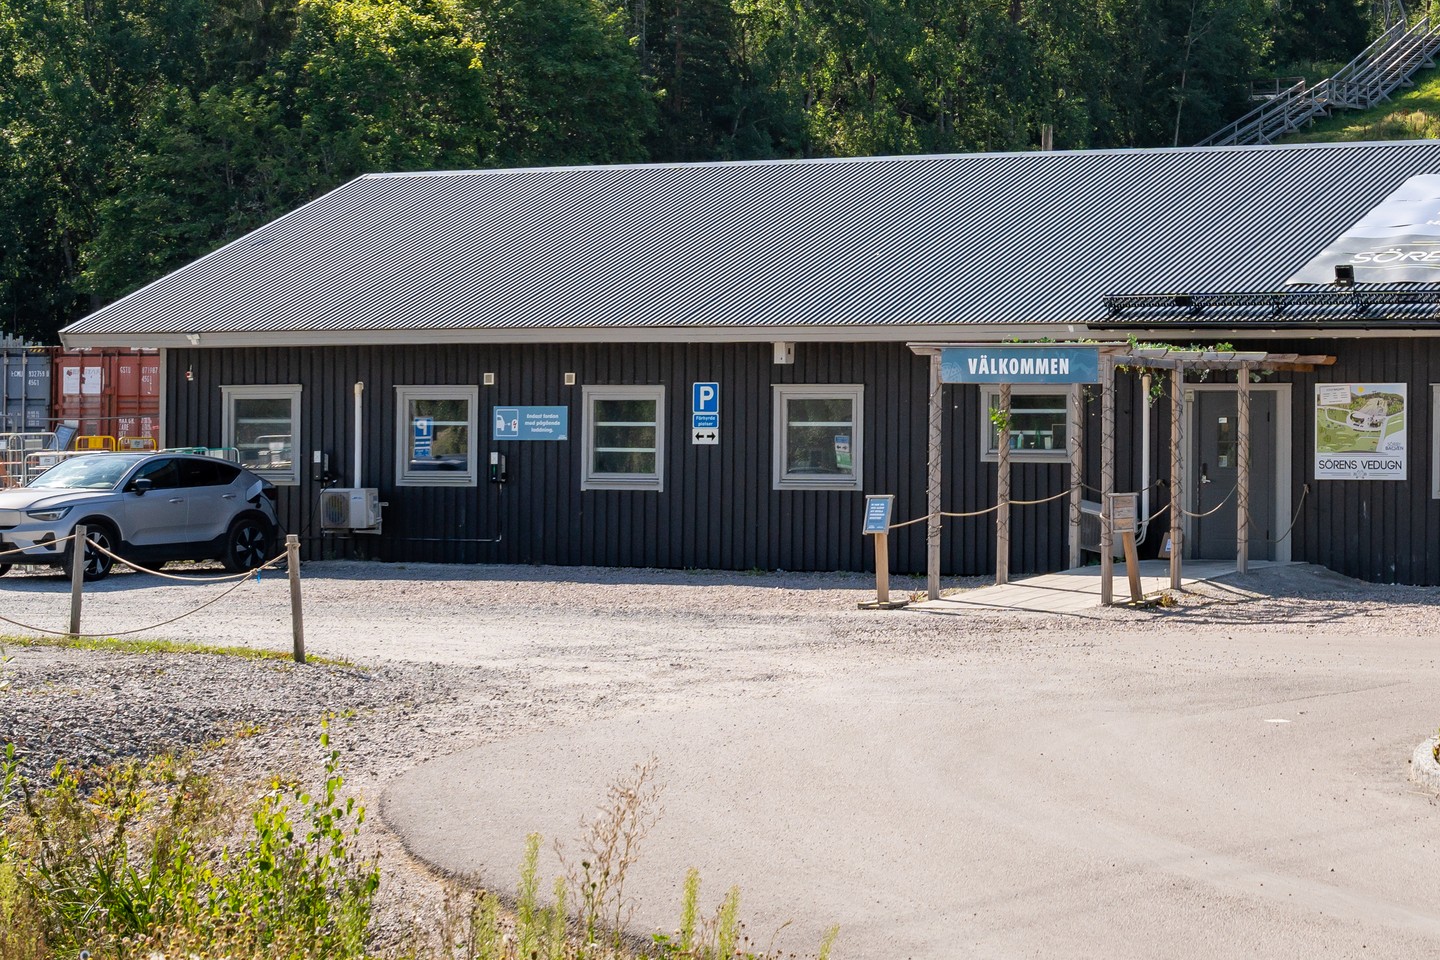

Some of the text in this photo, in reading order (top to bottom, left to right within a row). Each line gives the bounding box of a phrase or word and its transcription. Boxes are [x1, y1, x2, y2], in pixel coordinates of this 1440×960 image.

[967, 354, 1070, 375] VÄLKOMMEN
[700, 386, 714, 410] P
[1318, 458, 1402, 470] SÖRENS VEDUGN
